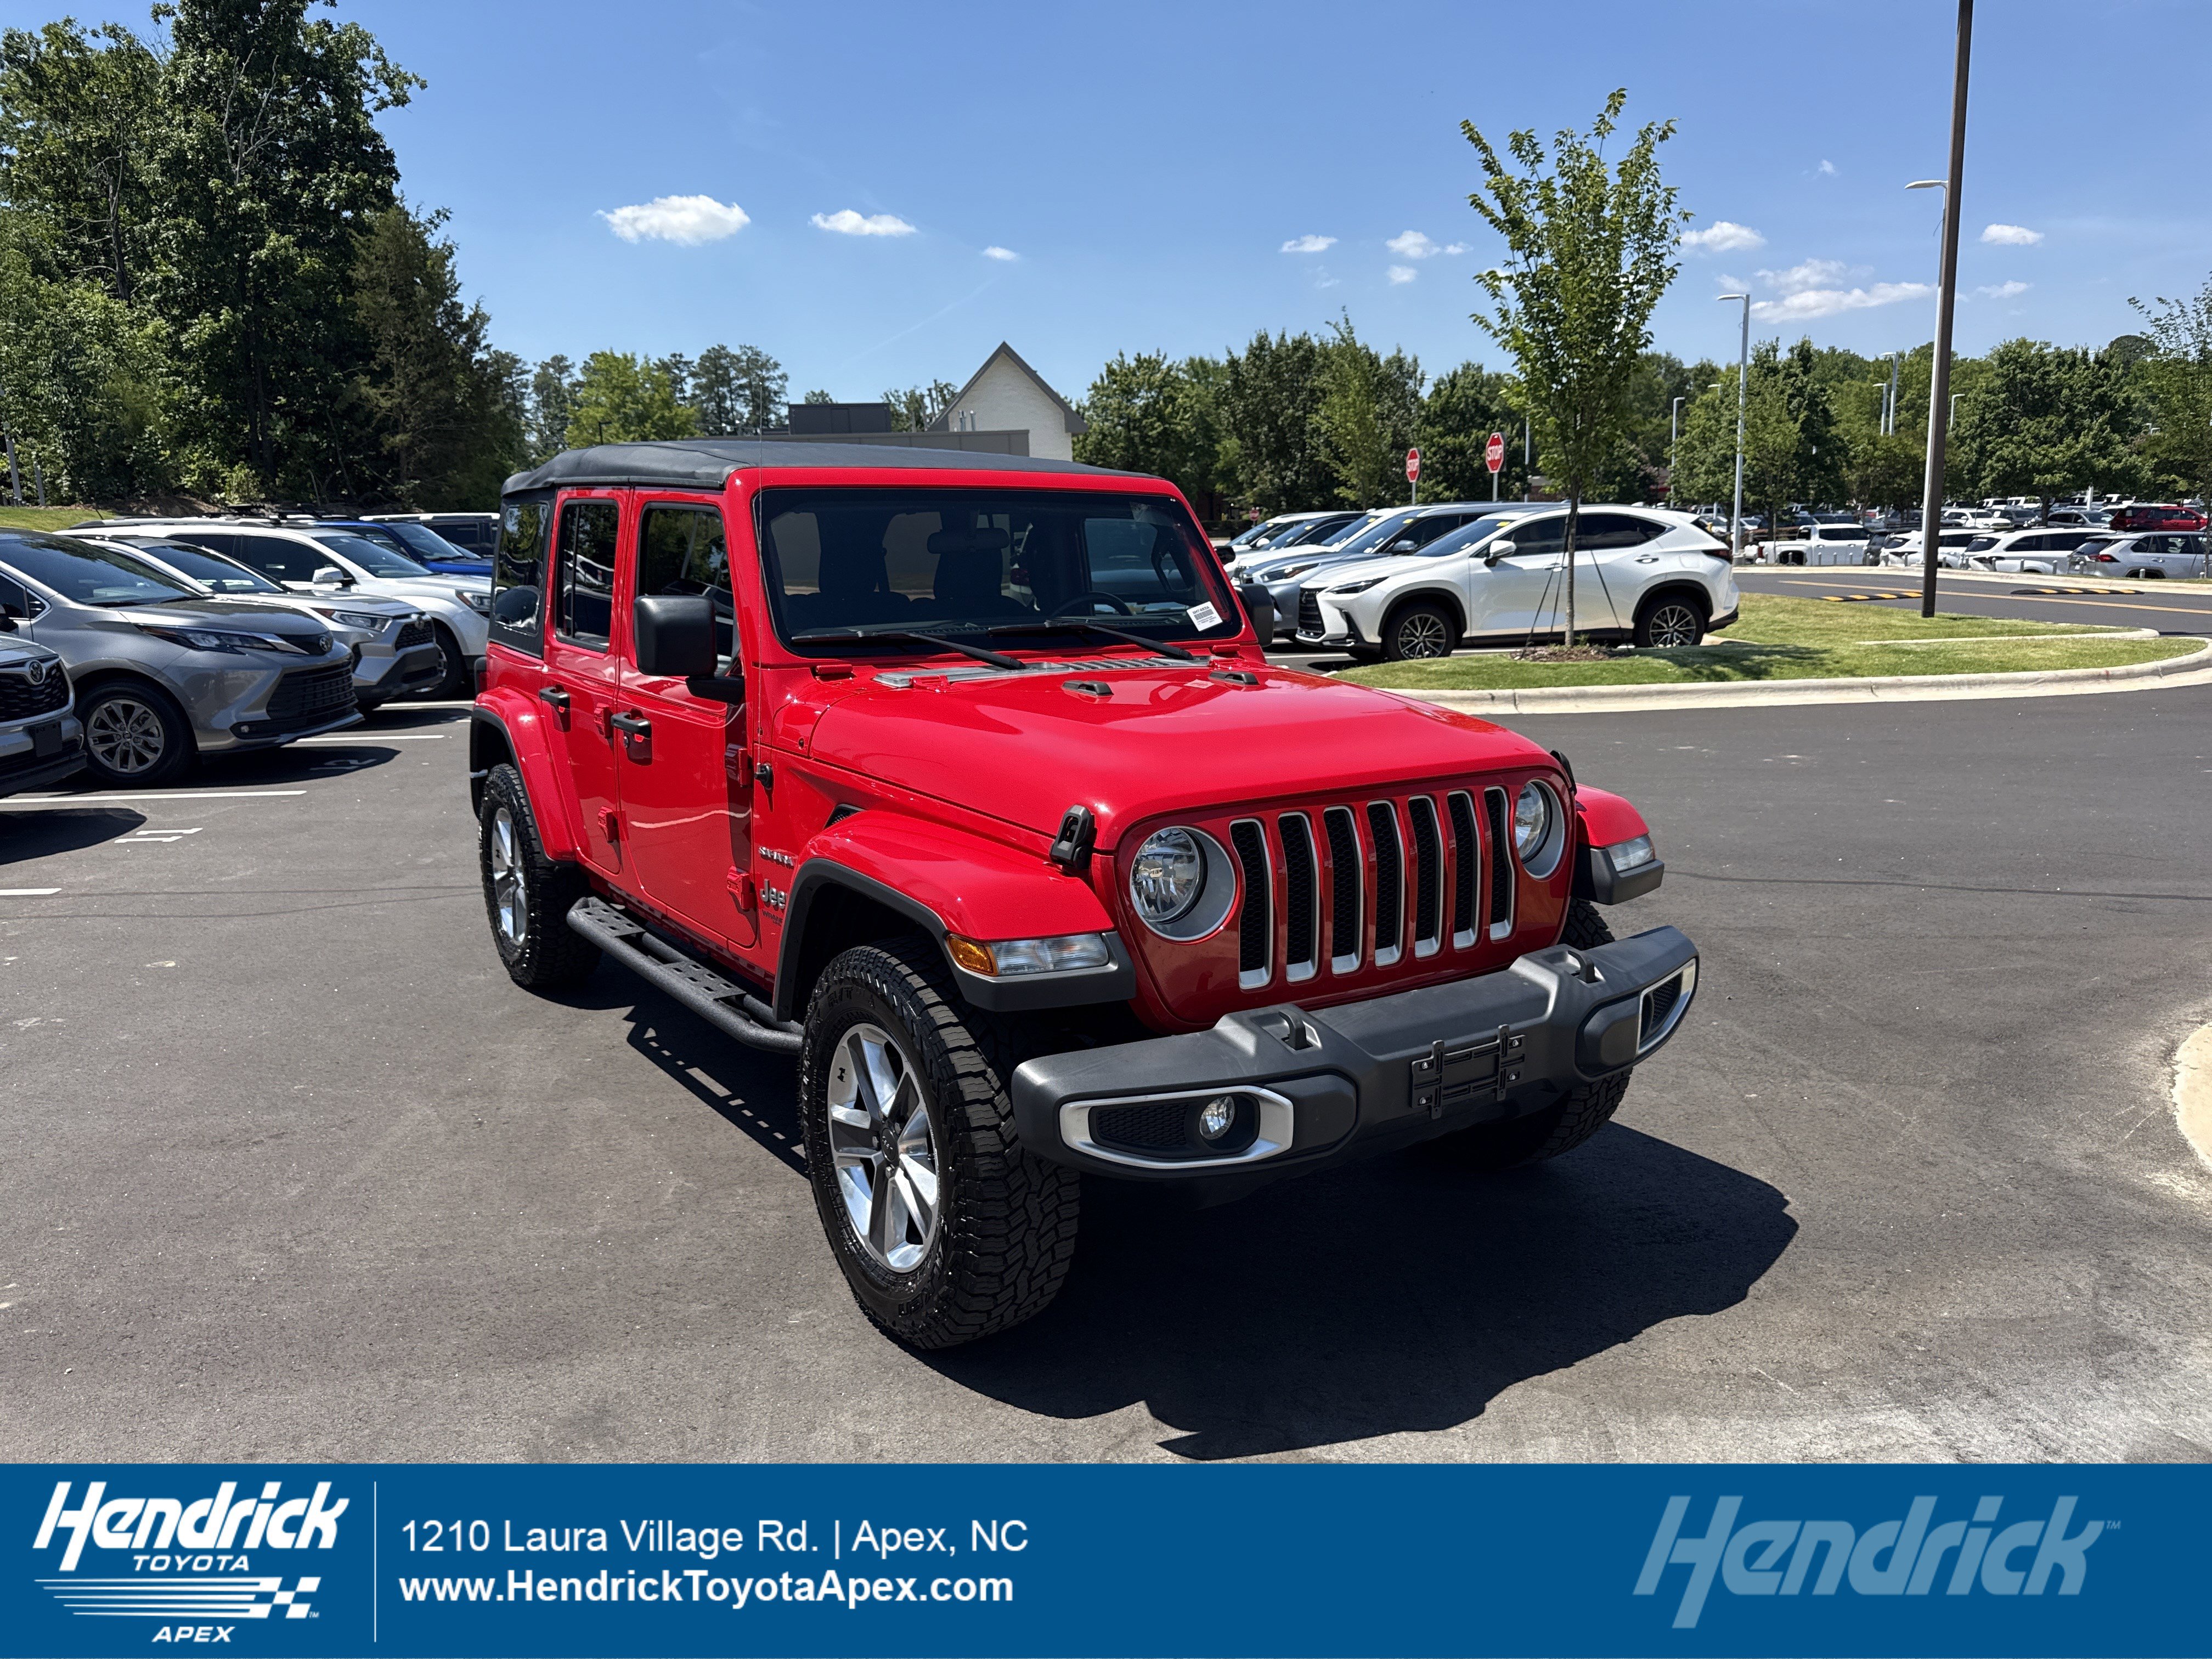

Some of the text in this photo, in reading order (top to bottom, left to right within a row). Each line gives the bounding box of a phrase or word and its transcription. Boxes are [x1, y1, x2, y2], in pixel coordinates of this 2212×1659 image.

[1487, 444, 1502, 461] STOP
[1407, 459, 1419, 472] STOP
[760, 878, 787, 910] Jee
